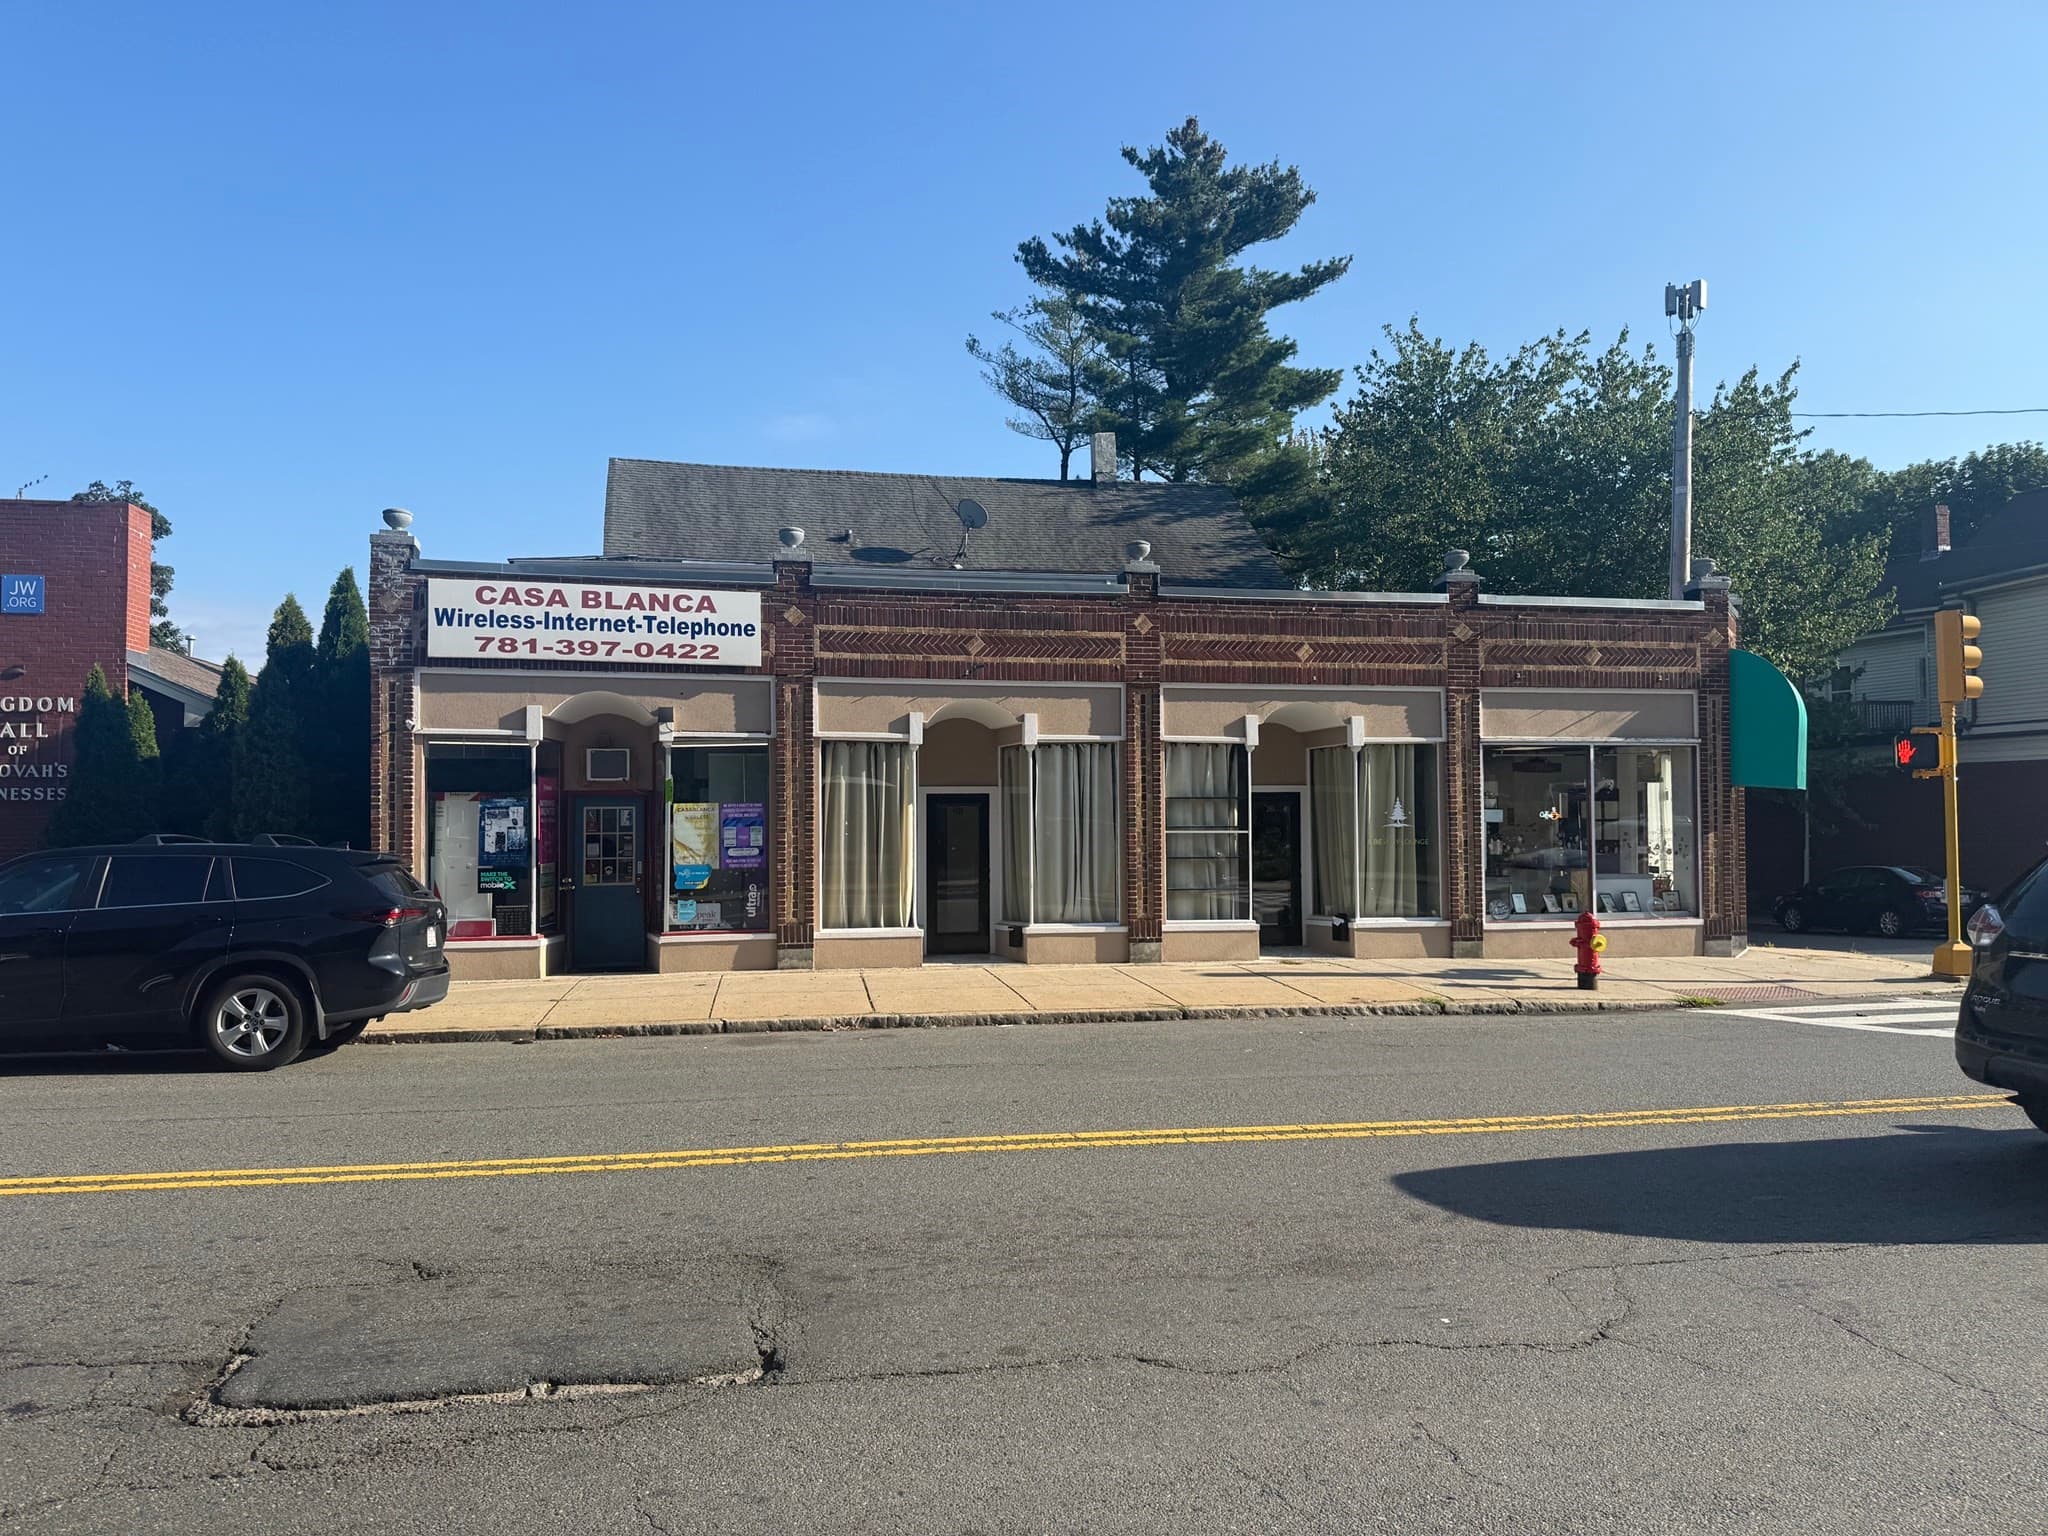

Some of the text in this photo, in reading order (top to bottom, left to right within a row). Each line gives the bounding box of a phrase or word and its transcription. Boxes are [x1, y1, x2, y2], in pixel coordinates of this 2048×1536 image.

[9, 580, 36, 595] JW
[7, 596, 37, 608] .ORG
[475, 585, 717, 613] CASA BLANCA
[434, 607, 756, 640] Wireless-Internet-Telephone
[474, 636, 720, 660] 781-397-0422
[7, 745, 28, 756] OF
